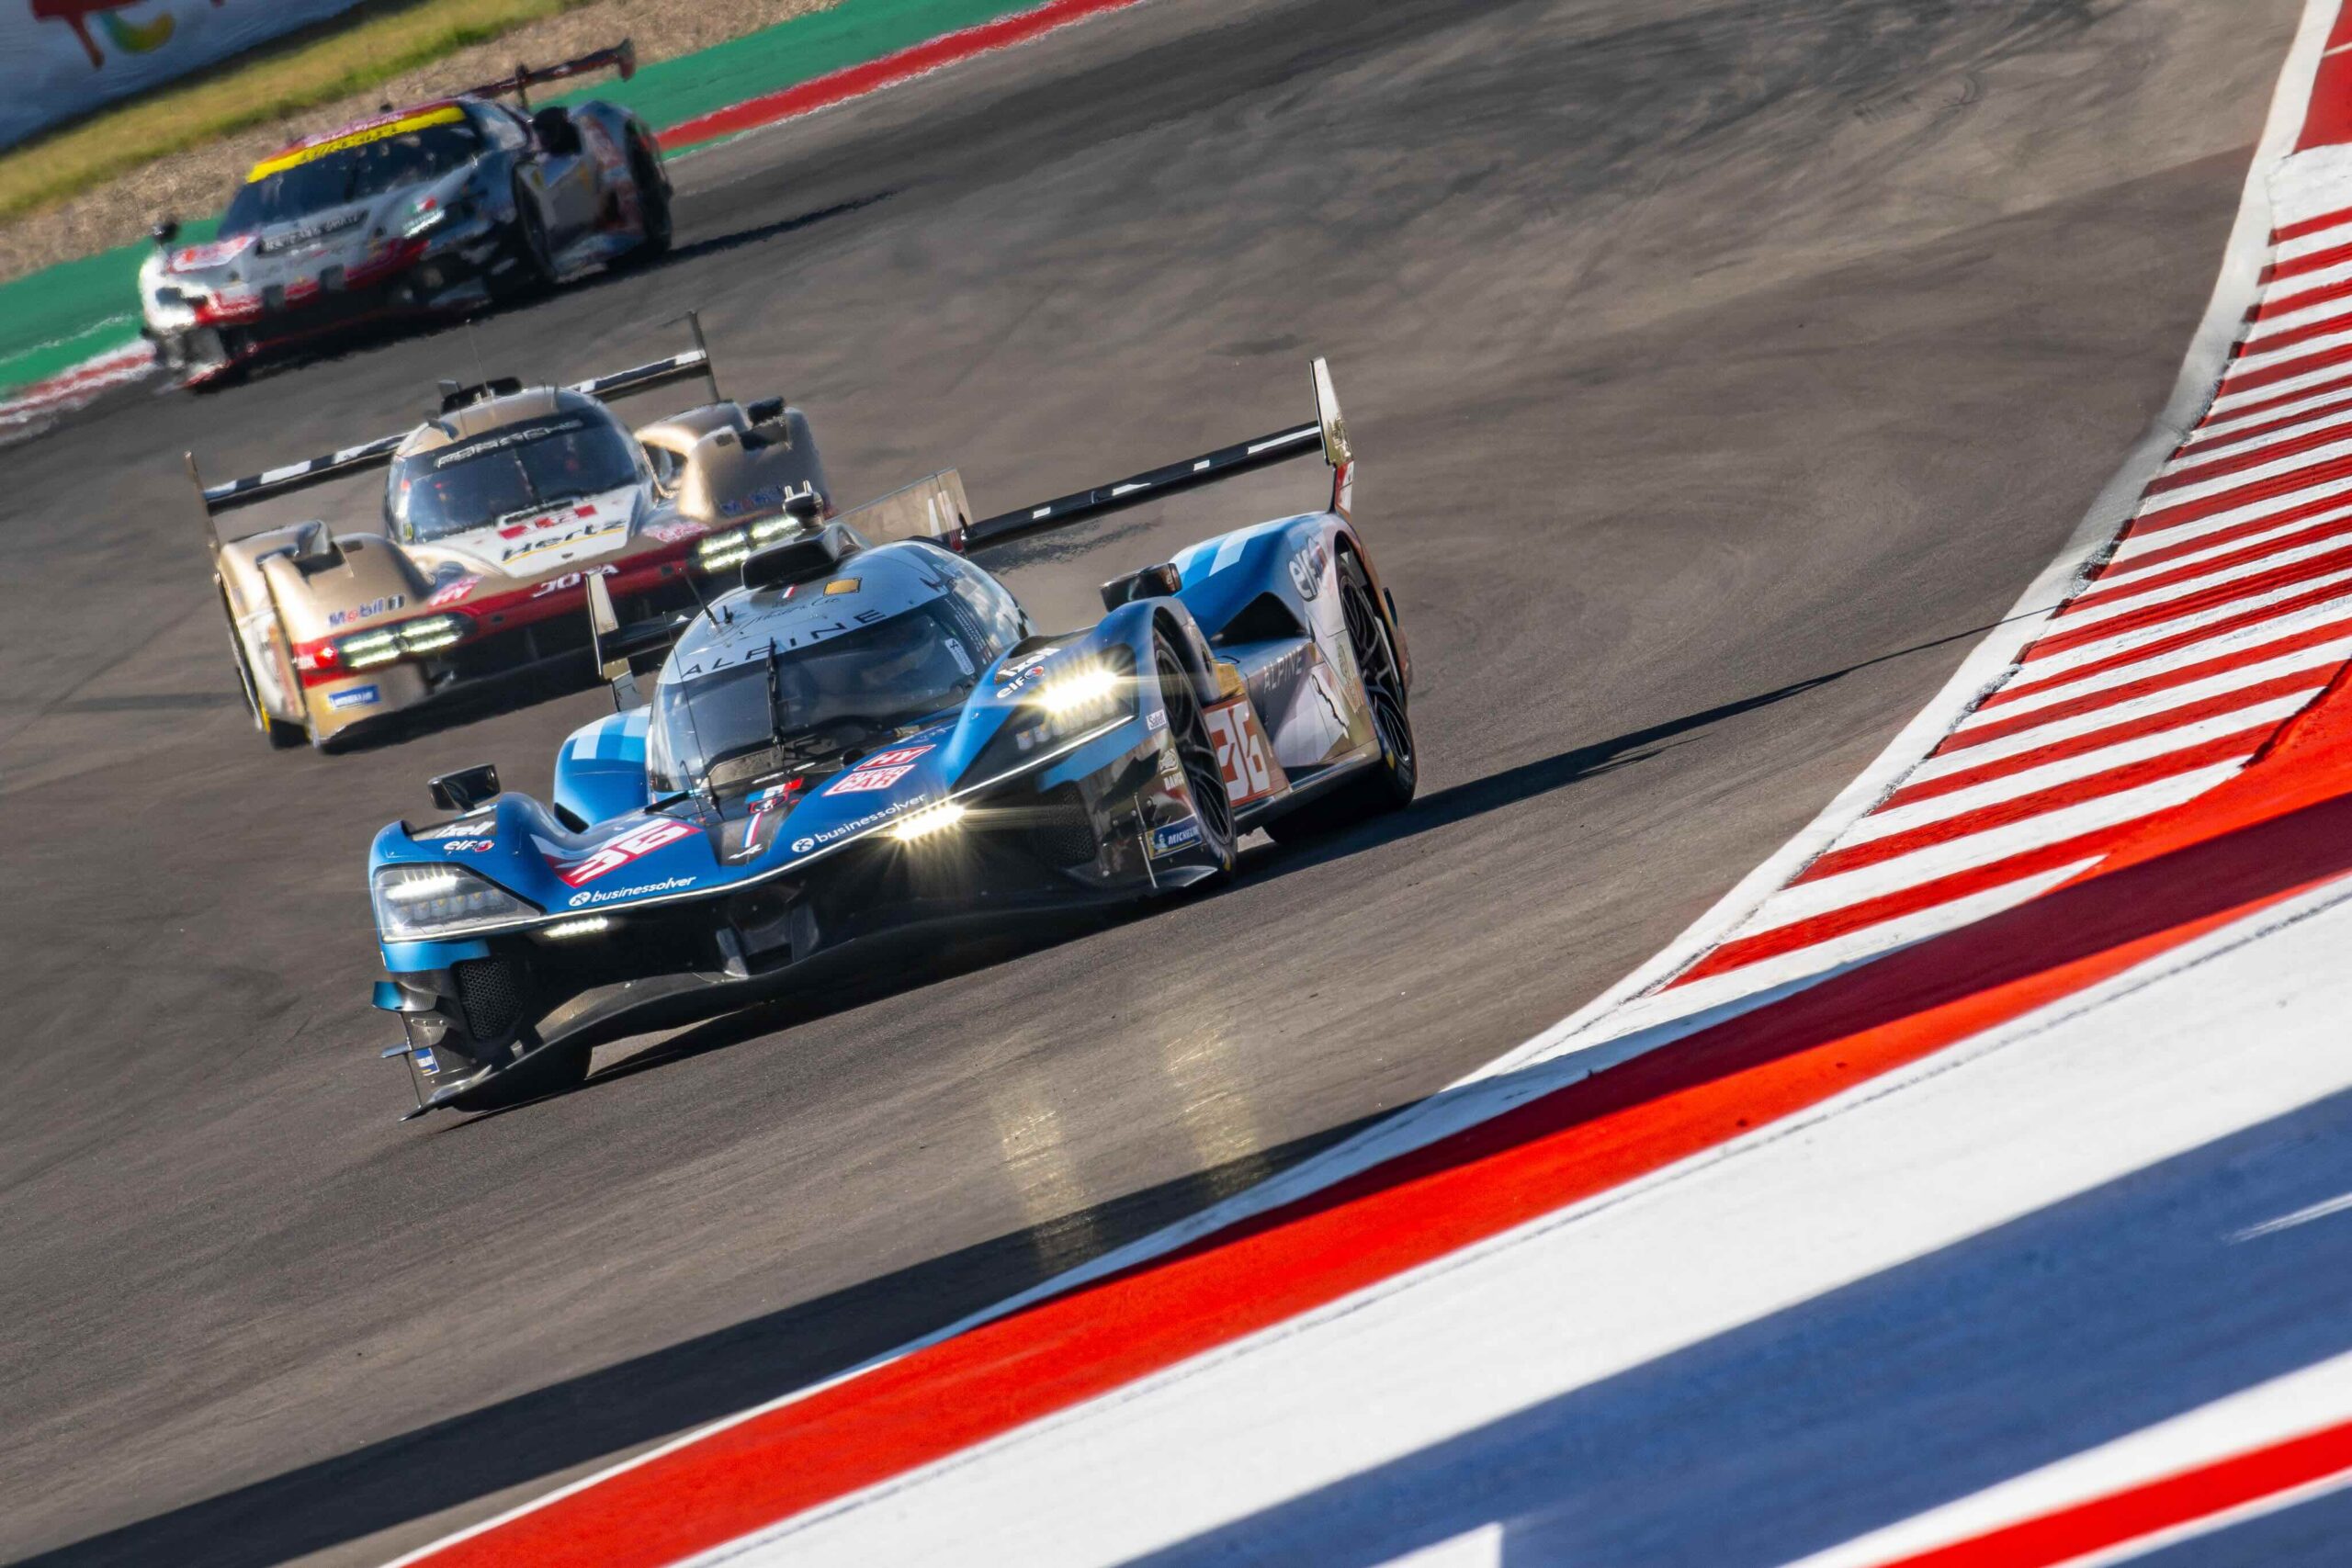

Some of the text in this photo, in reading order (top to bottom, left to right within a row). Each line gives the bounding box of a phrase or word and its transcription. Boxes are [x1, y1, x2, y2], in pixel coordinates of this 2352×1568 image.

[328, 598, 384, 626] Mobil
[1263, 645, 1304, 695] ALPINE
[997, 676, 1025, 698] elf
[1204, 701, 1271, 801] 36
[817, 794, 926, 844] businessolver
[443, 840, 479, 851] elf
[592, 875, 696, 903] businessolver
